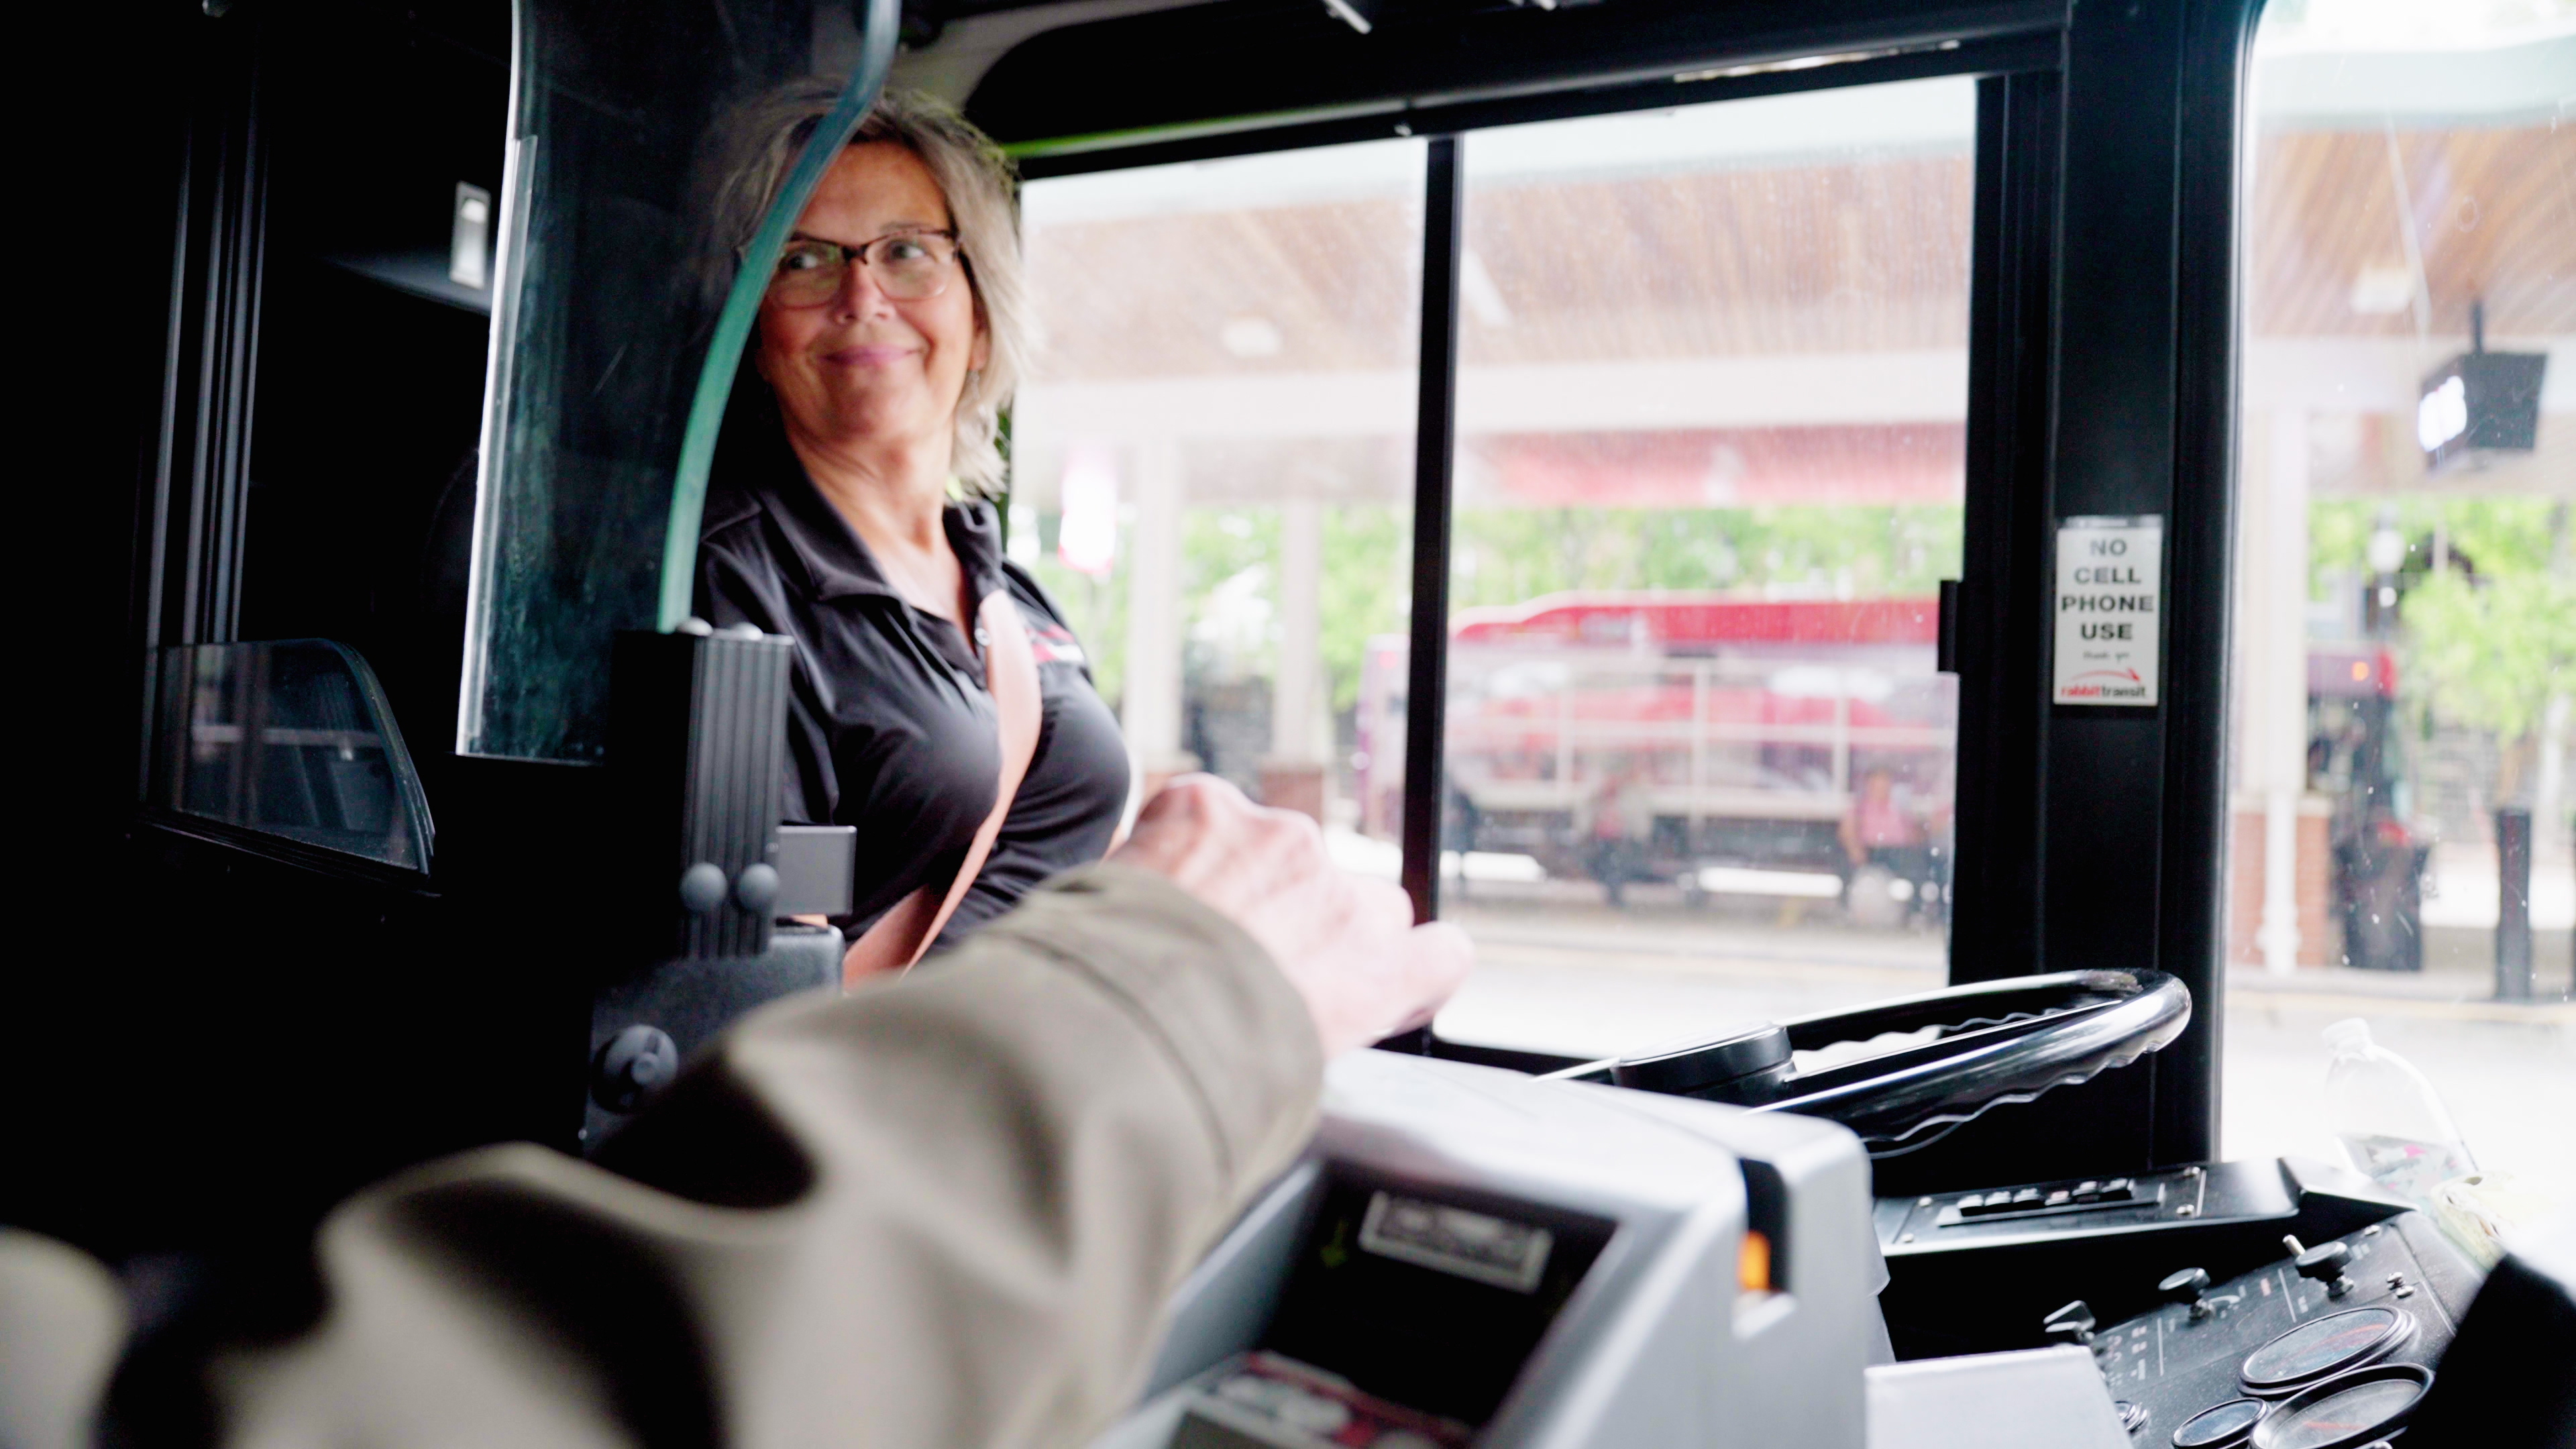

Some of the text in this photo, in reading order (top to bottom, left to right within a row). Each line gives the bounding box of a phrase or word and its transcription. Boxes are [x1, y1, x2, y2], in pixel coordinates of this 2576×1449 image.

[2090, 539, 2127, 555] NO
[2074, 568, 2141, 584] CELL
[2061, 596, 2154, 611] PHONE
[2081, 624, 2132, 639] USE
